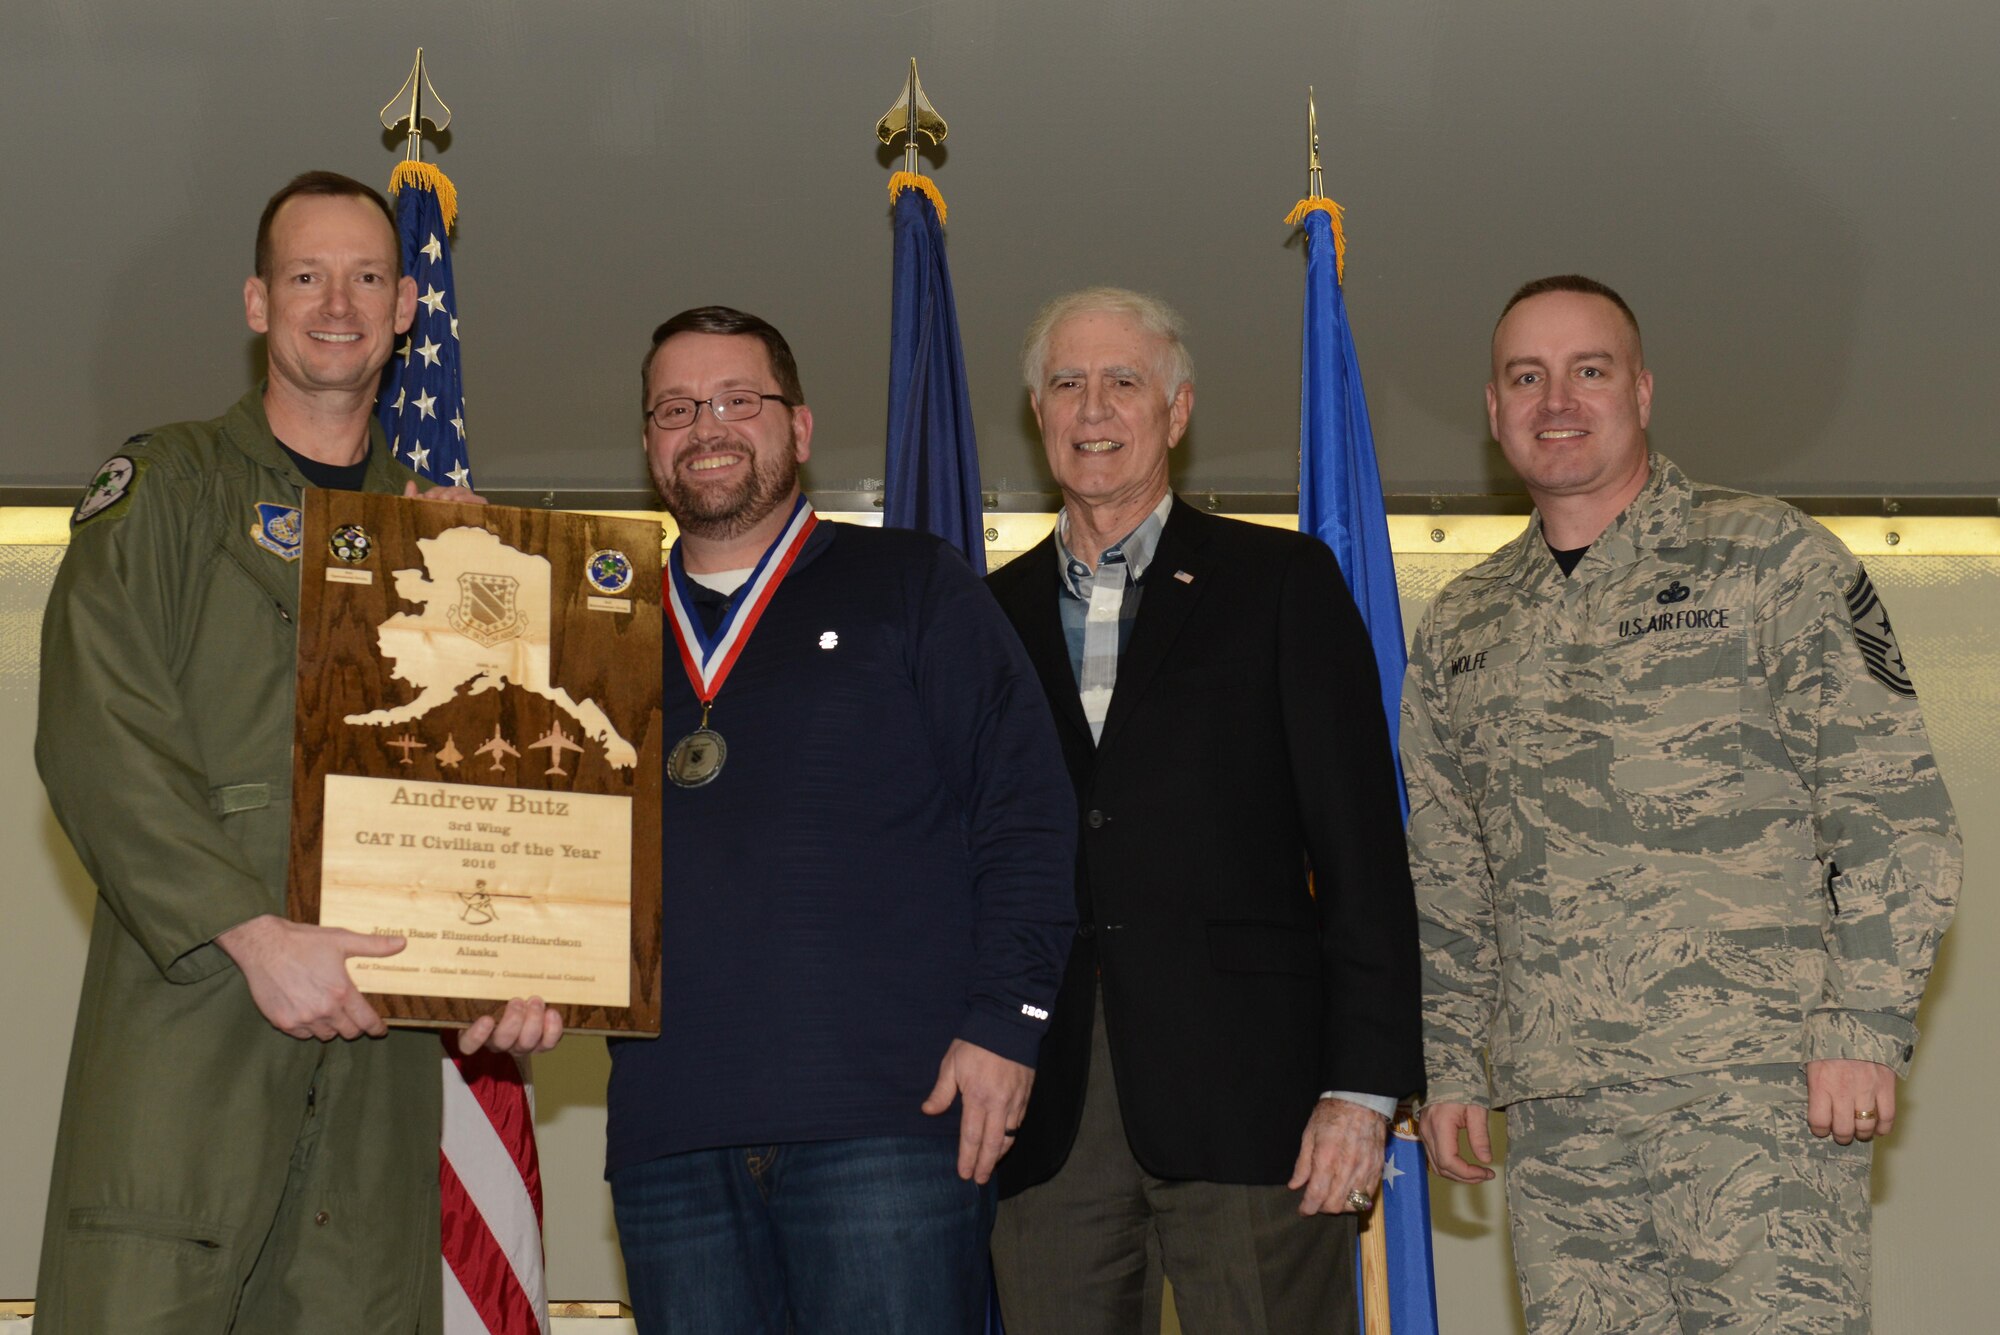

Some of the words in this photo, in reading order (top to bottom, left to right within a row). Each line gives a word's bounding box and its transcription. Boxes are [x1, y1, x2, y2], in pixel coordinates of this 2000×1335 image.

[1646, 613, 1673, 634] AIR
[1676, 609, 1729, 630] FORCE
[1451, 651, 1488, 676] WOLFE
[391, 786, 498, 812] Andrew
[506, 793, 569, 816] Butz
[448, 821, 472, 833] 3rd
[477, 822, 511, 836] Wing
[355, 831, 394, 846] CAT
[399, 834, 416, 847] II
[422, 834, 495, 853] Civilian
[501, 841, 521, 854] of
[525, 843, 554, 857] the
[560, 844, 602, 860] Year
[462, 858, 496, 870] 2016
[408, 928, 438, 940] Base
[441, 929, 582, 948] Elmendorf-Richardson
[456, 946, 499, 958] Alaska
